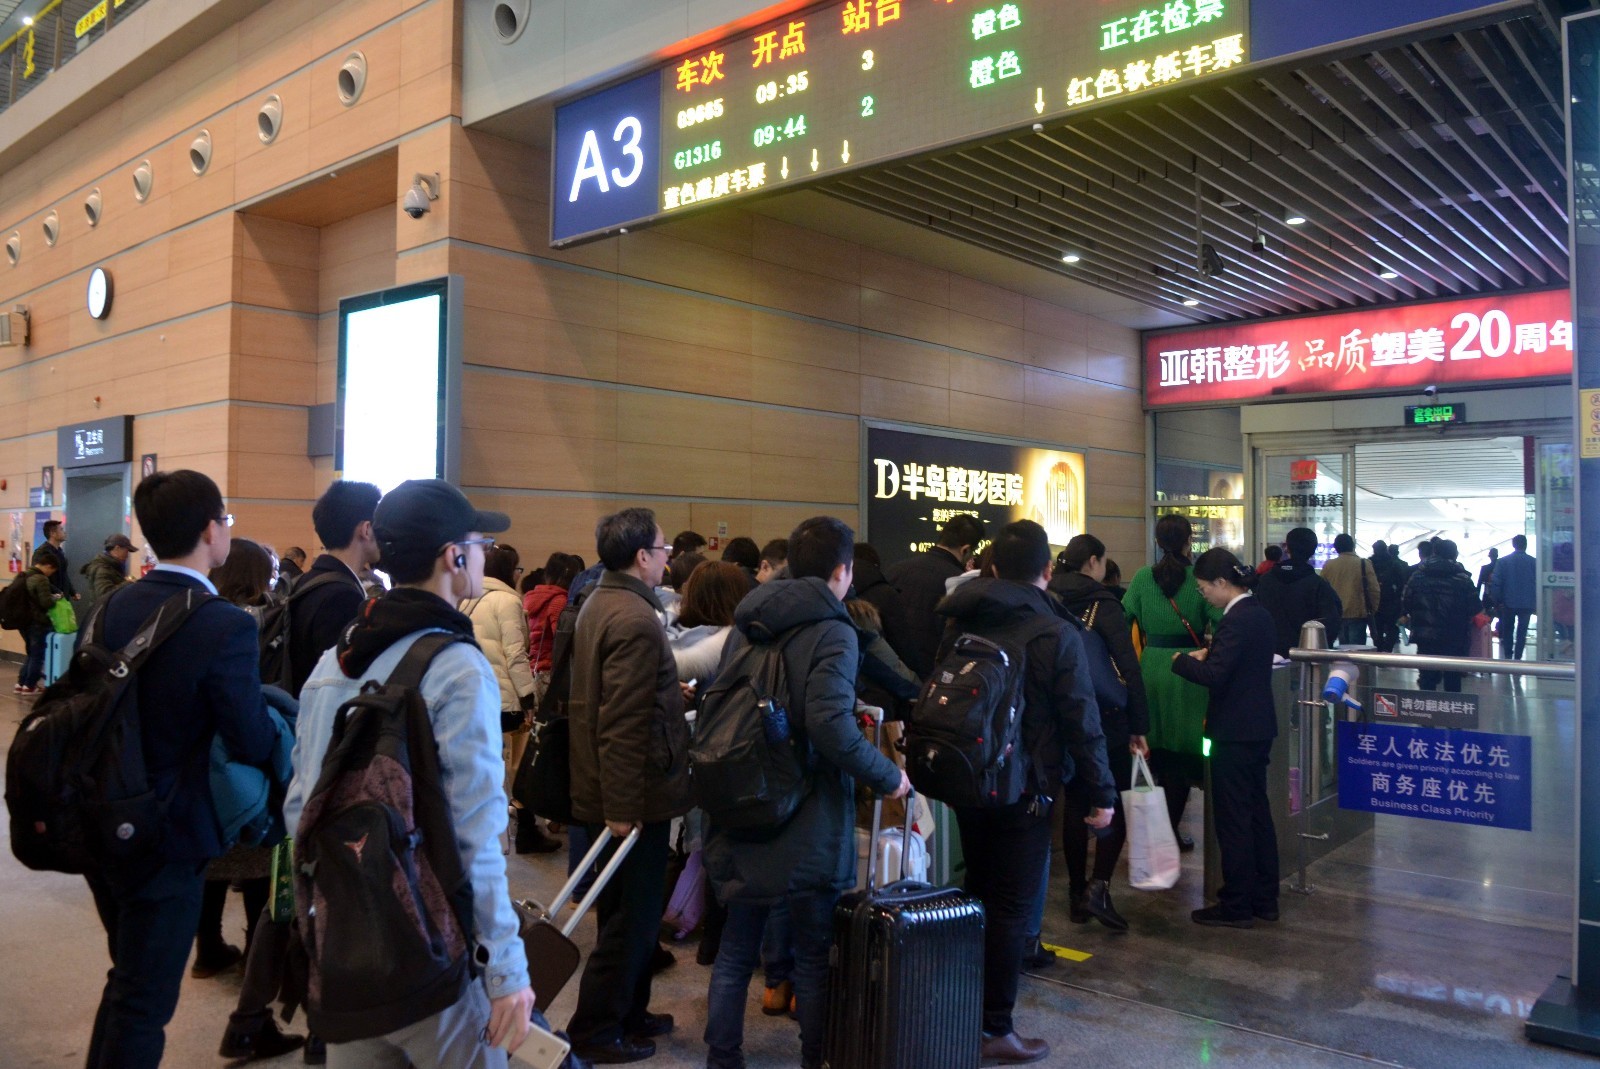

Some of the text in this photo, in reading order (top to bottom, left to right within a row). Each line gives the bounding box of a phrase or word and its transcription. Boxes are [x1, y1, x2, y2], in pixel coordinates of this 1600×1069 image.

[676, 0, 900, 92] 车次 开点 站台
[755, 70, 809, 104] 09:35
[861, 49, 874, 71] 3
[970, 3, 1022, 40] 橙色
[674, 0, 1224, 170] G1316 09:44 2 橙色 正在检票
[568, 116, 644, 203] A3
[1414, 406, 1453, 416] 安全出口
[901, 462, 1024, 506] 半岛整形医院
[1401, 698, 1475, 715] 请勿翻越栏杆
[1357, 733, 1511, 768] 军人依法优先
[1348, 756, 1380, 767] Soldiers
[1396, 762, 1419, 771] given
[1420, 765, 1450, 775] priority
[1451, 768, 1493, 780] according
[1494, 771, 1503, 779] to
[1504, 772, 1521, 781] law
[1370, 772, 1496, 805] 商务座优先
[1370, 797, 1496, 821] Business Class Priority
